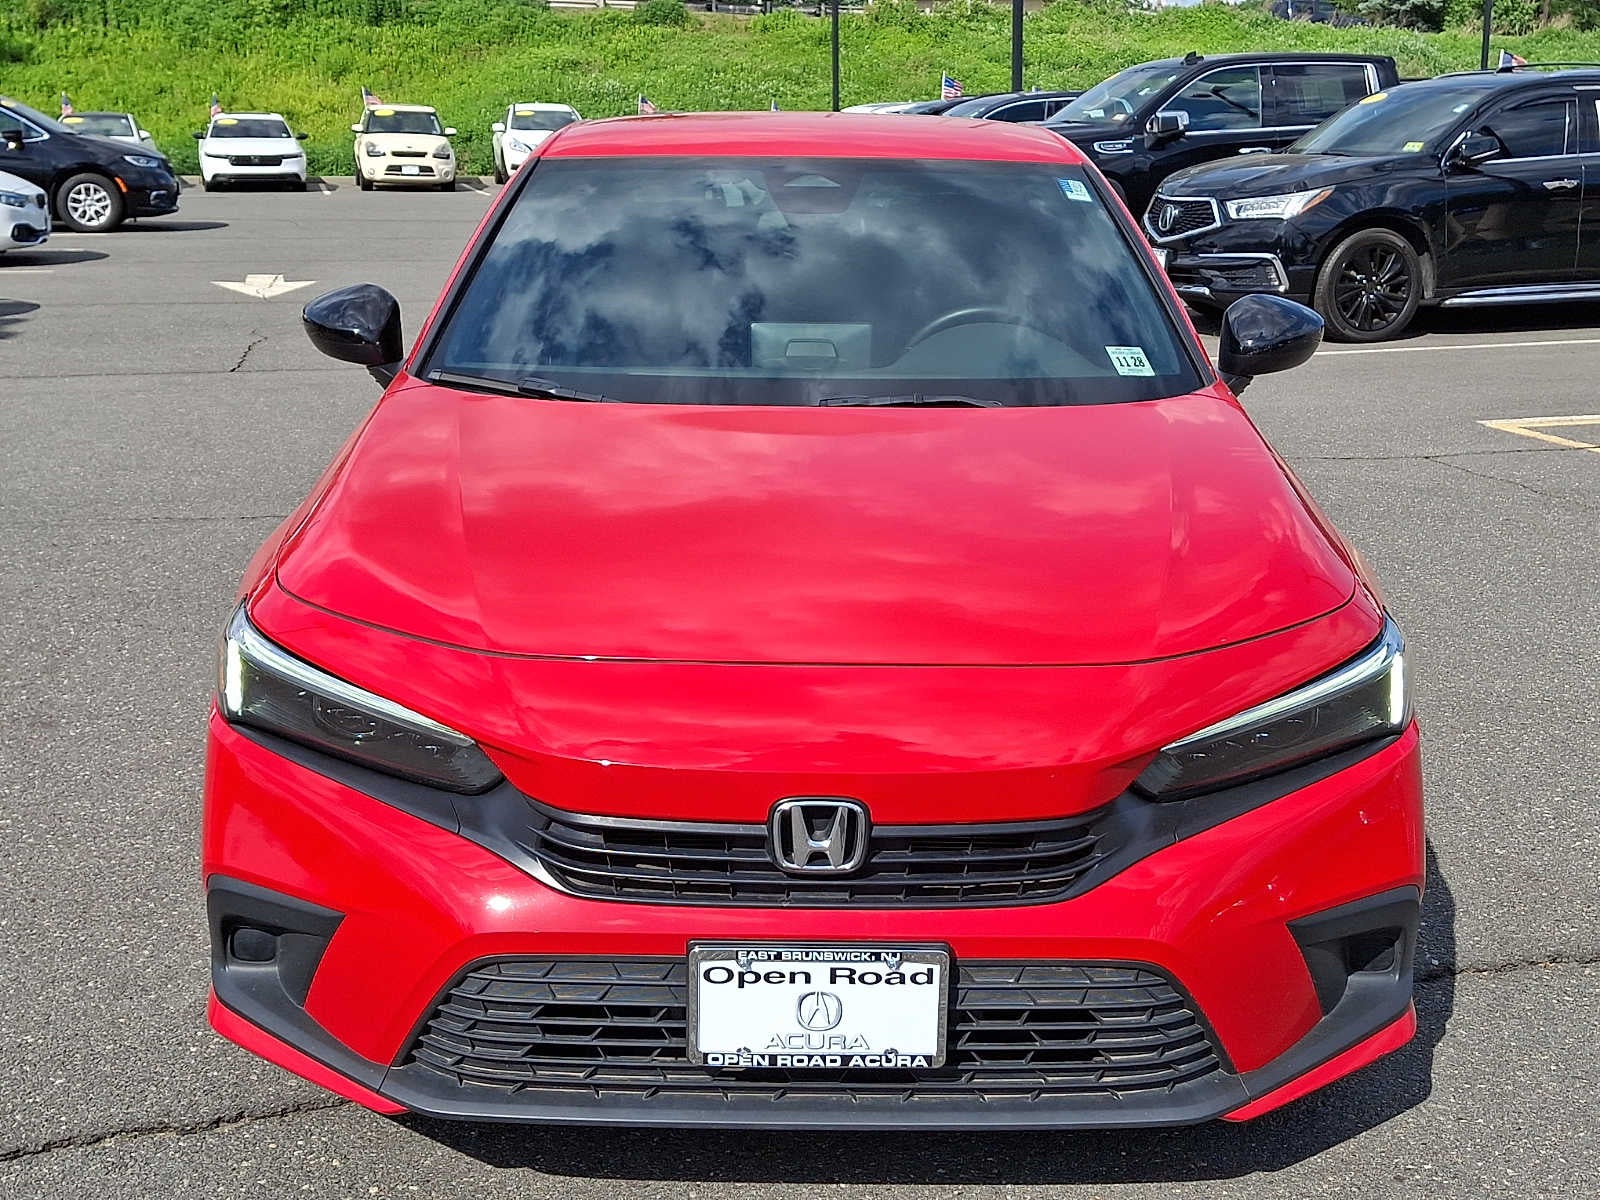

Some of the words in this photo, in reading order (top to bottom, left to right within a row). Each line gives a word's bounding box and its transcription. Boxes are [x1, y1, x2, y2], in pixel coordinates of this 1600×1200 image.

[737, 950, 777, 960] EAST
[781, 951, 875, 961] BRUNSWICK,
[880, 952, 901, 961] NJ
[703, 966, 811, 988] Open
[829, 967, 934, 985] Road
[764, 1033, 870, 1050] ACURA
[707, 1053, 770, 1066] OPEN
[776, 1054, 841, 1067] ROAD
[848, 1055, 929, 1068] ACURA
